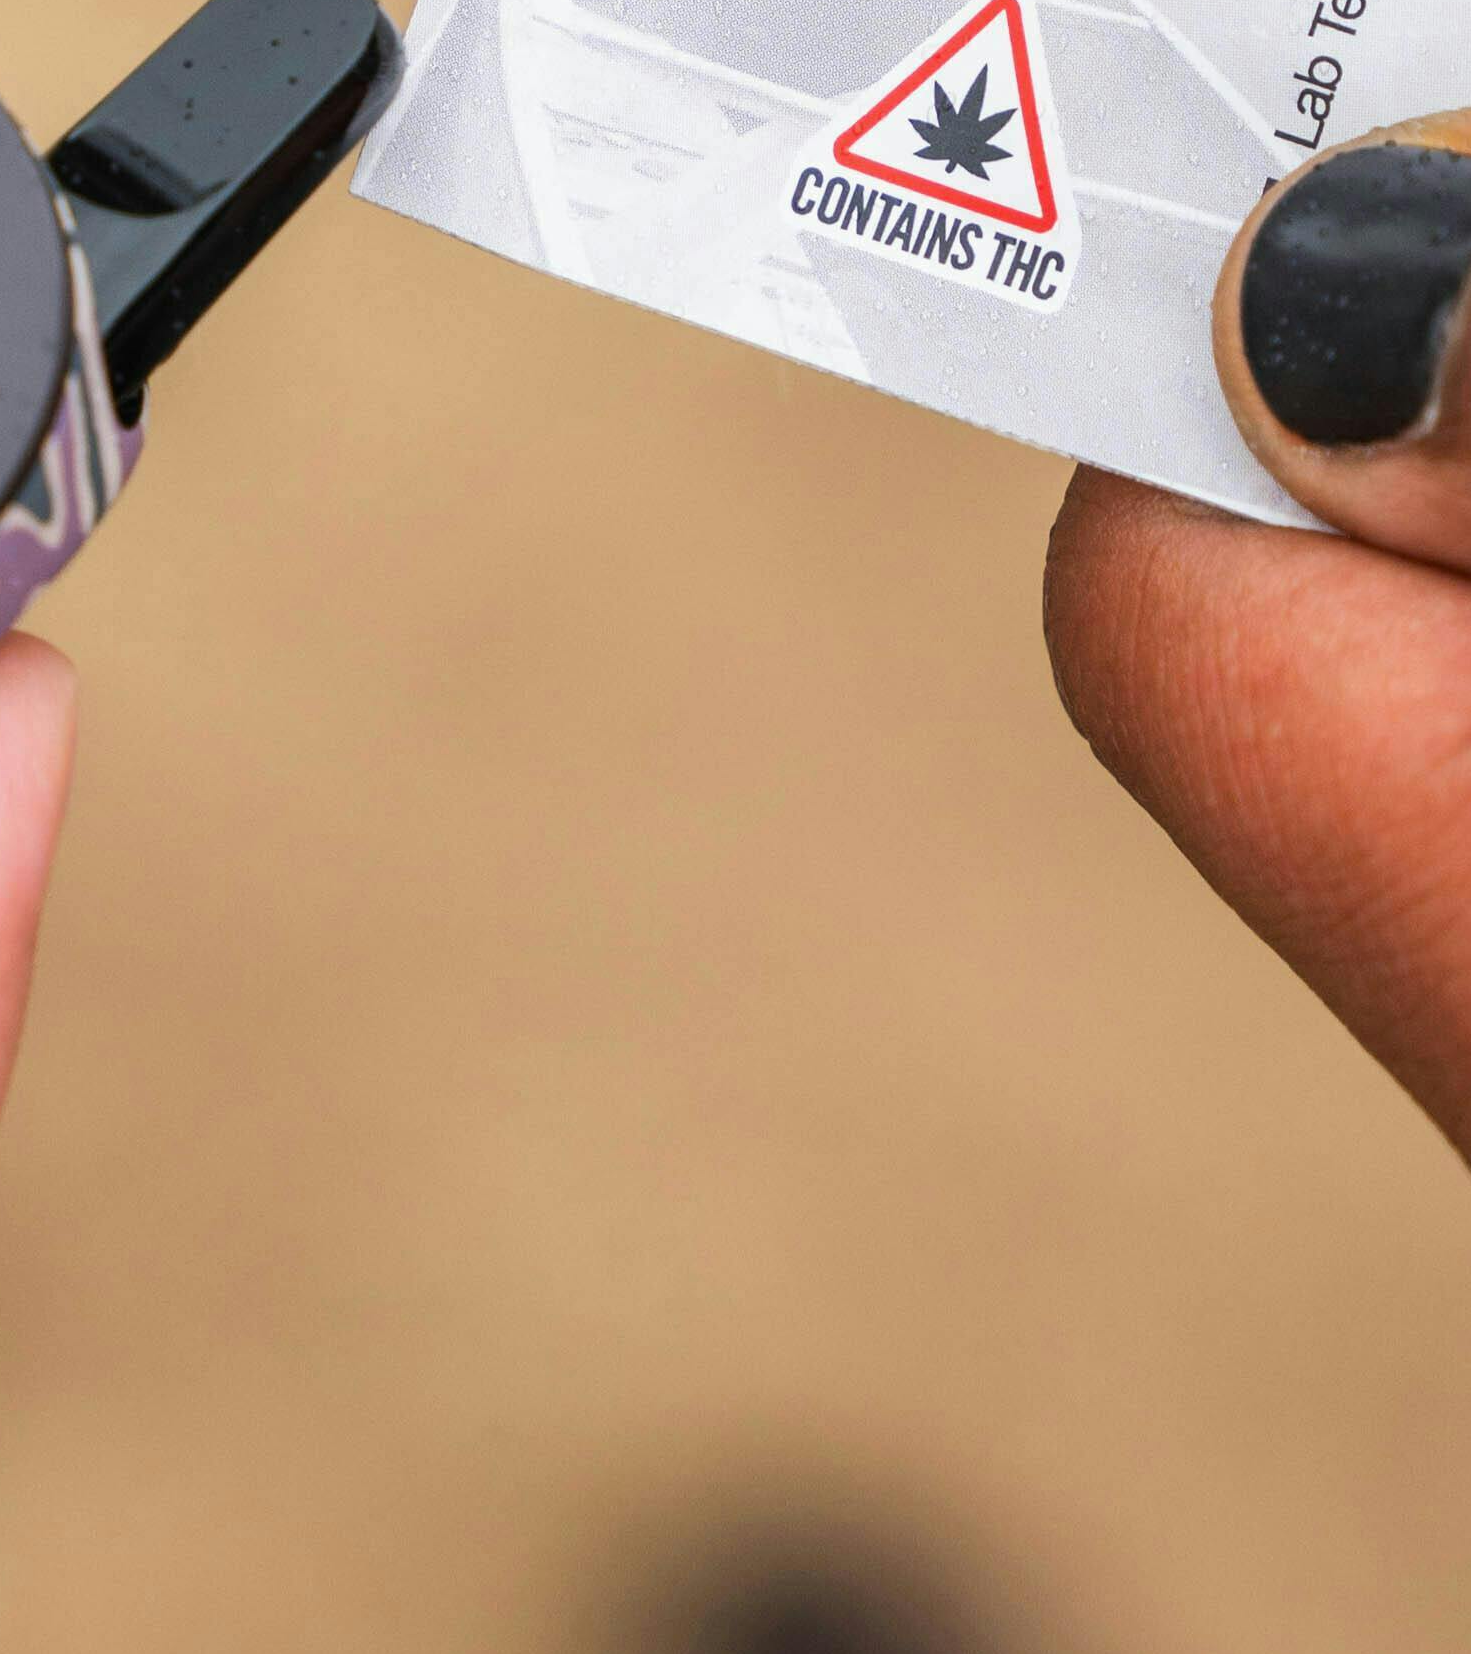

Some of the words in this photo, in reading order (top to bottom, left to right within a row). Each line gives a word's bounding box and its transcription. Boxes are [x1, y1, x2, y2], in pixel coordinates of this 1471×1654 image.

[1274, 55, 1343, 150] Lab
[790, 165, 985, 273] CONTAINS
[982, 231, 1066, 302] THC
